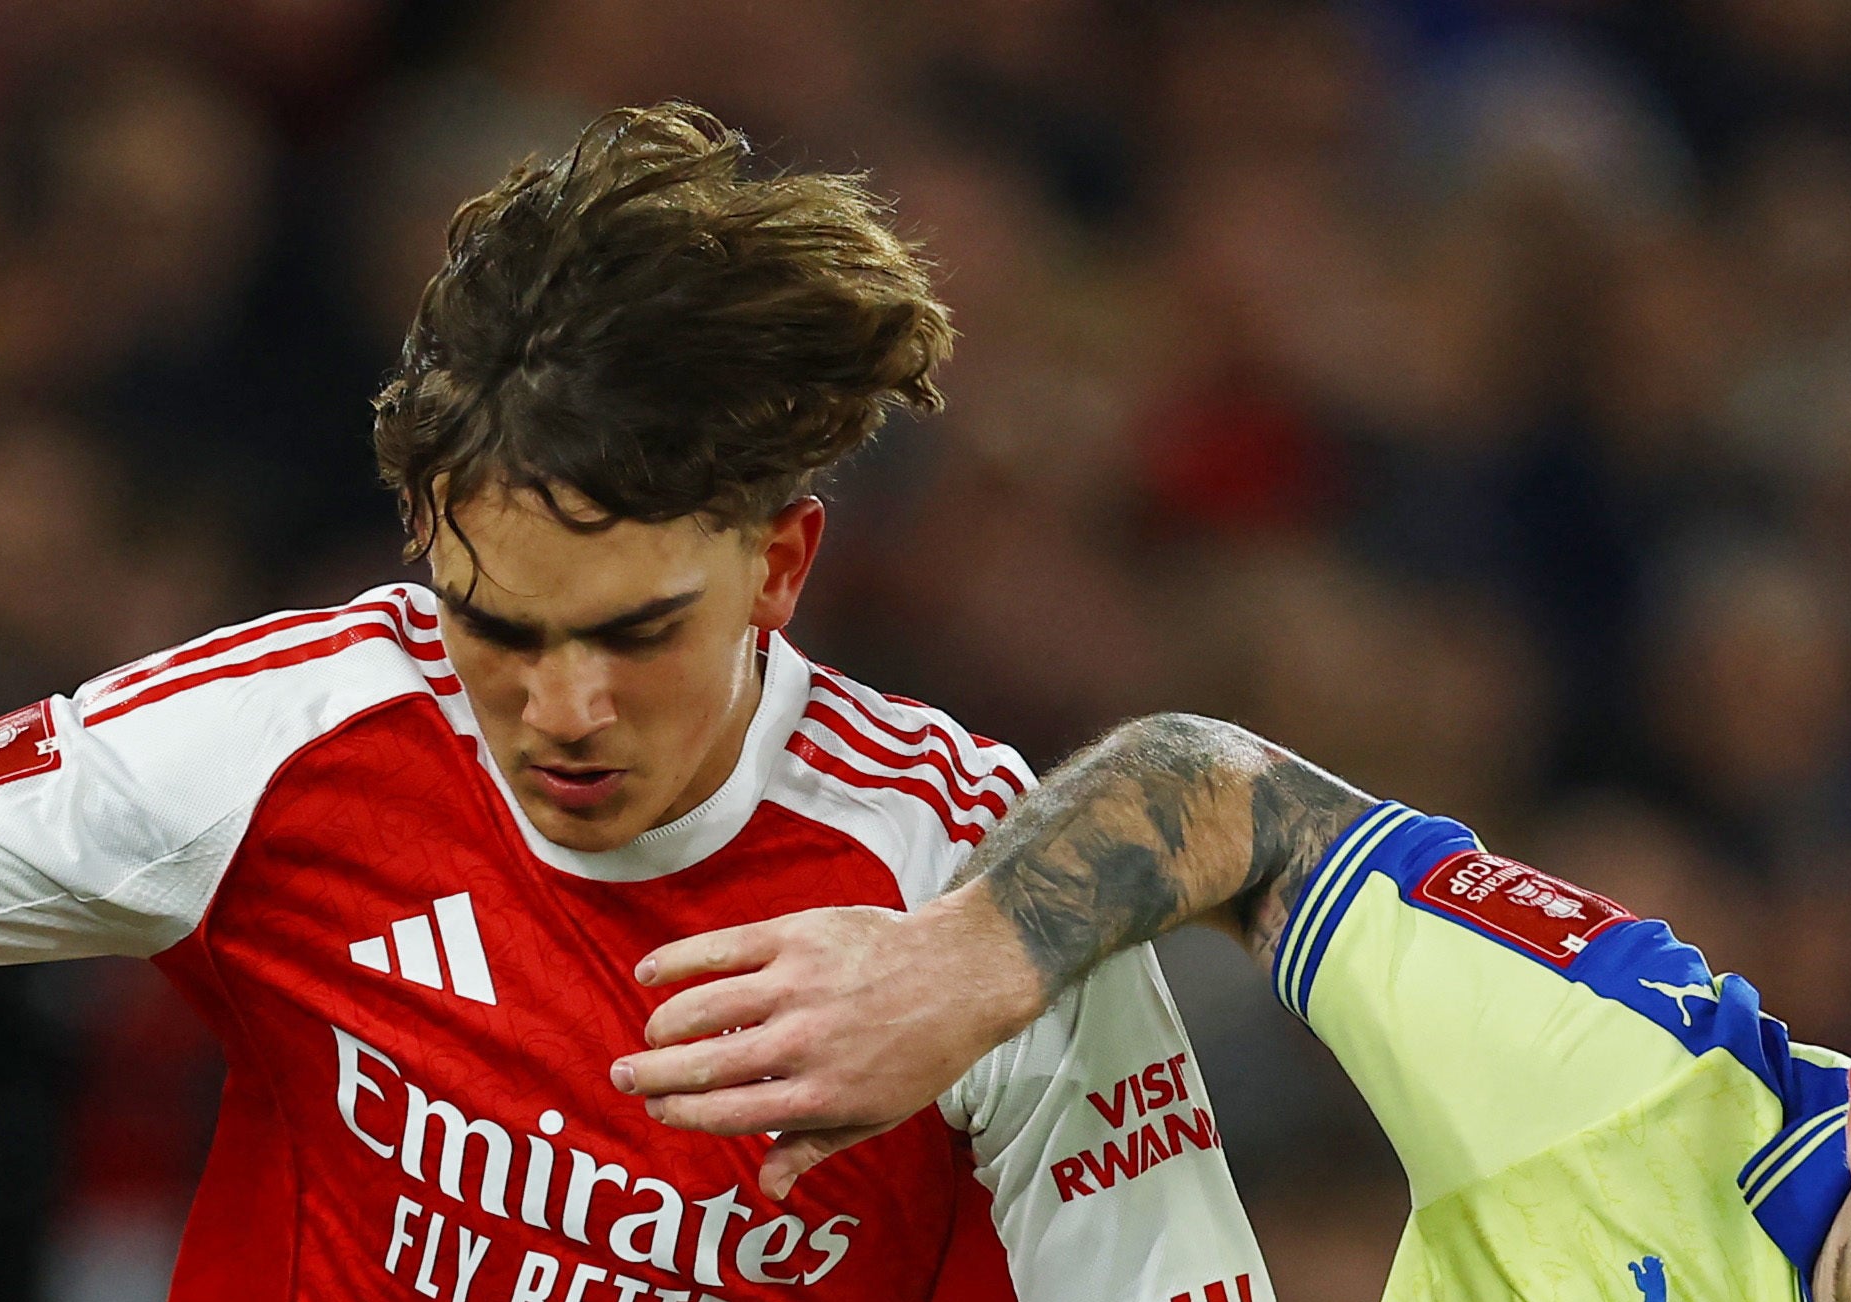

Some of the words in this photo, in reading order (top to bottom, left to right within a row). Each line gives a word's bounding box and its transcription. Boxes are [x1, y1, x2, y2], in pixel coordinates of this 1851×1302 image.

[1449, 862, 1493, 896] CUP
[330, 1023, 860, 1287] Emirates
[1050, 1107, 1223, 1203] RWAN
